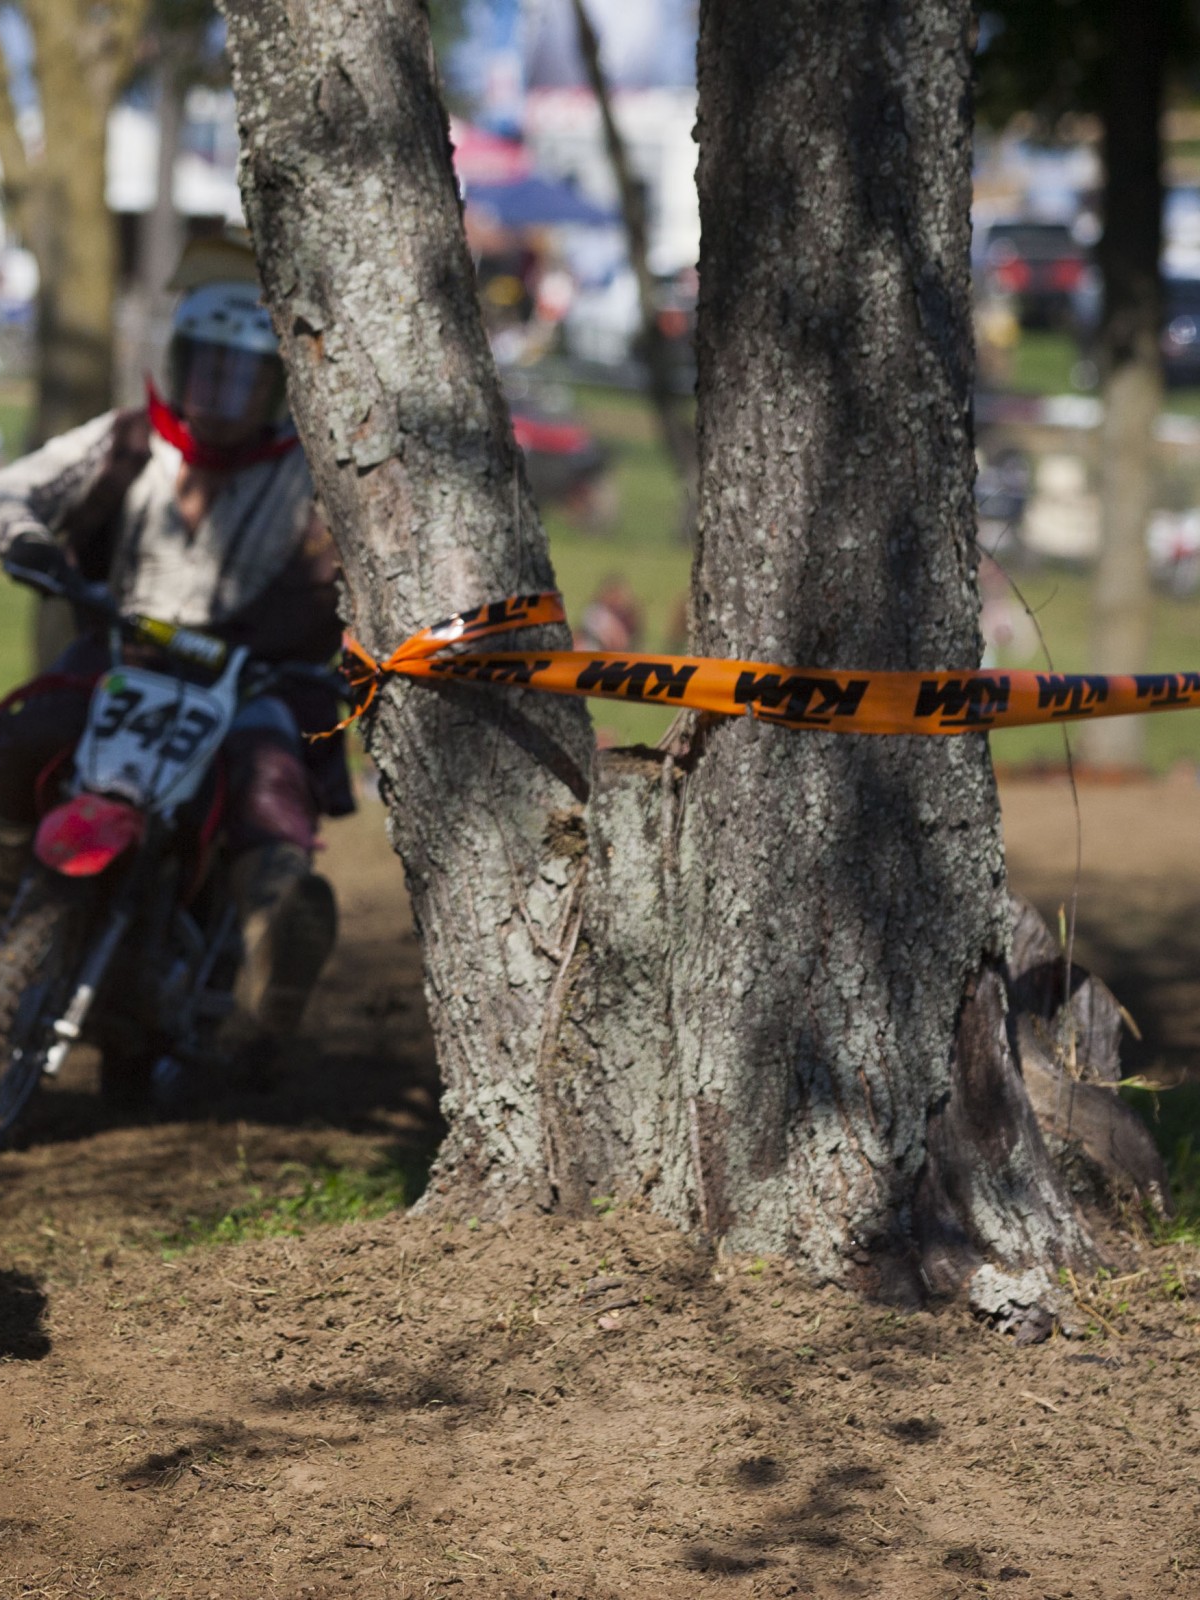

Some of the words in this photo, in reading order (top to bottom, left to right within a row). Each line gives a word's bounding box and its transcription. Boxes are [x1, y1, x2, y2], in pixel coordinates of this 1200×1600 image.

[95, 690, 219, 763] 343
[734, 671, 870, 725] KTM
[914, 675, 1010, 727] KTM
[1036, 674, 1109, 717] KTM
